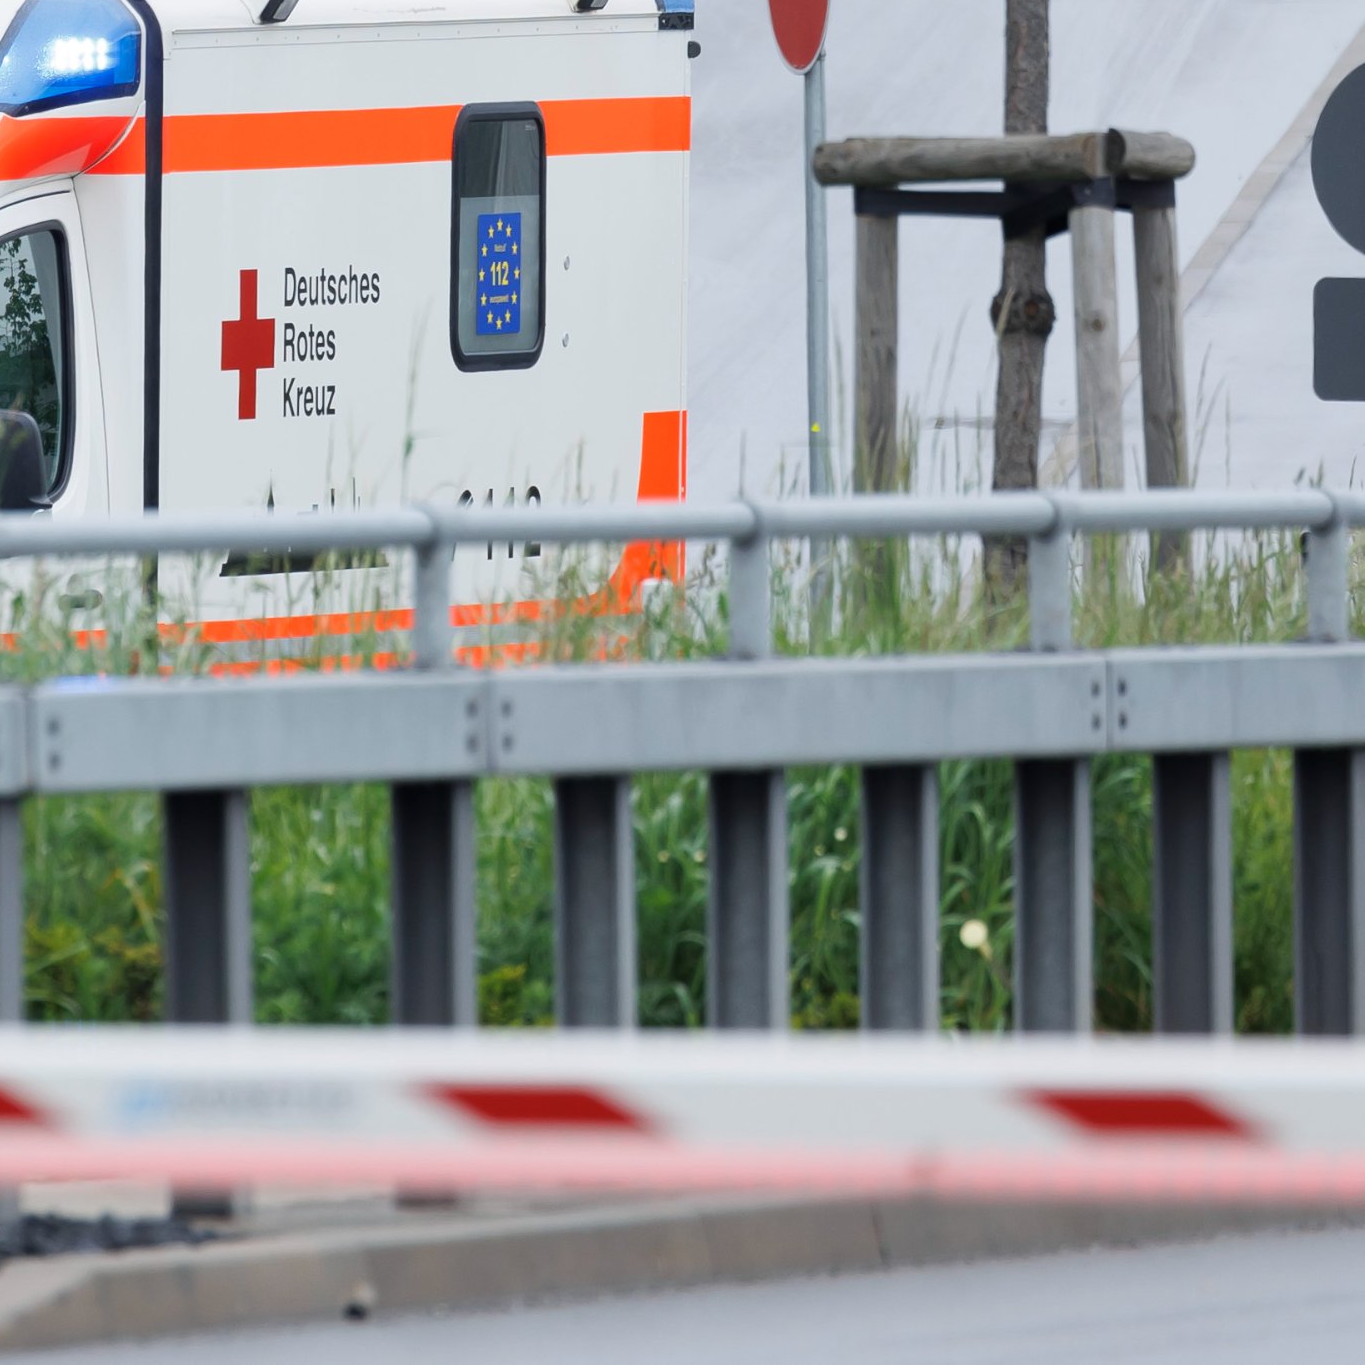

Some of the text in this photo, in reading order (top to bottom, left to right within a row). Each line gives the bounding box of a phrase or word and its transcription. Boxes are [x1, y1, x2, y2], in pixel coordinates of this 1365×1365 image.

[284, 264, 380, 307] Deutsches
[490, 261, 509, 286] 112
[283, 322, 336, 362] Rotes
[283, 377, 336, 417] Kreuz
